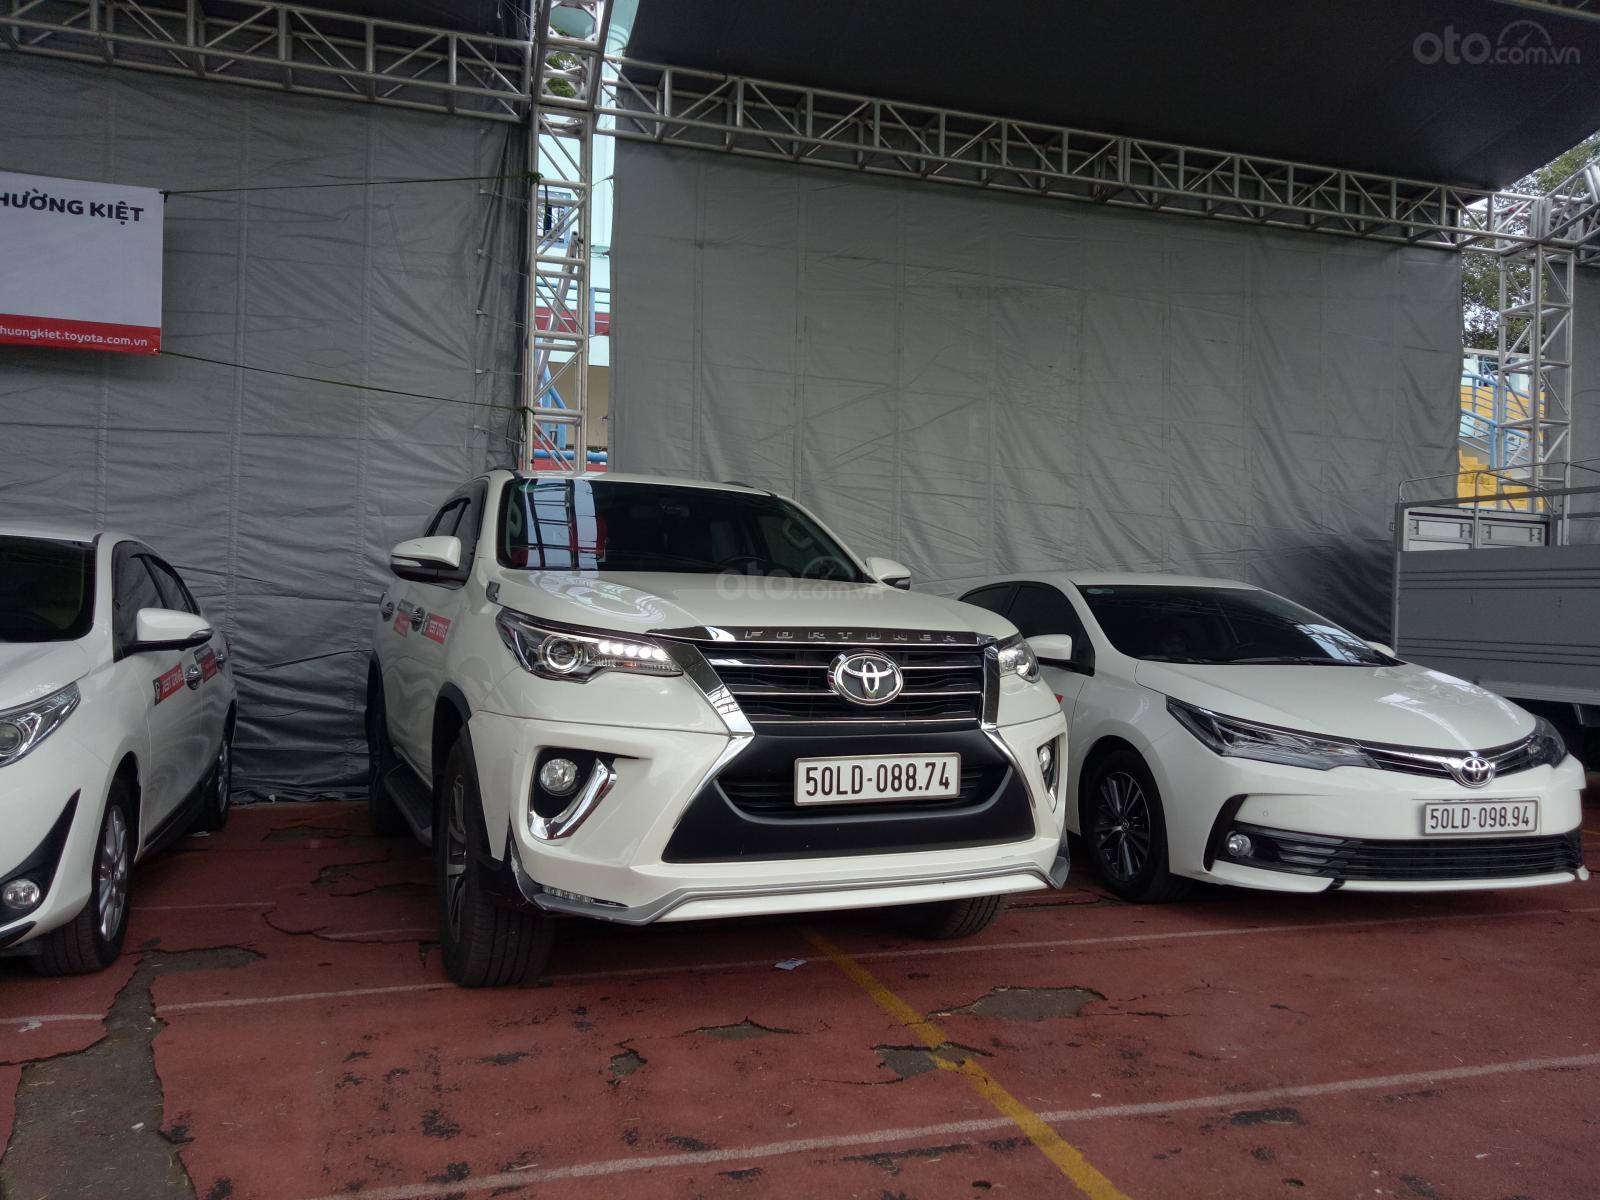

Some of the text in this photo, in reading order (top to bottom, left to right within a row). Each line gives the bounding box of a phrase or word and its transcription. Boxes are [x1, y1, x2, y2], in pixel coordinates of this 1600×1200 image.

[90, 201, 144, 225] KIỆT
[0, 325, 148, 346] huongkiet.toyota.com.vn
[745, 629, 957, 643] FORTUNER
[805, 761, 950, 796] 50LD-088.74
[1430, 806, 1529, 829] 50LD-098.94
